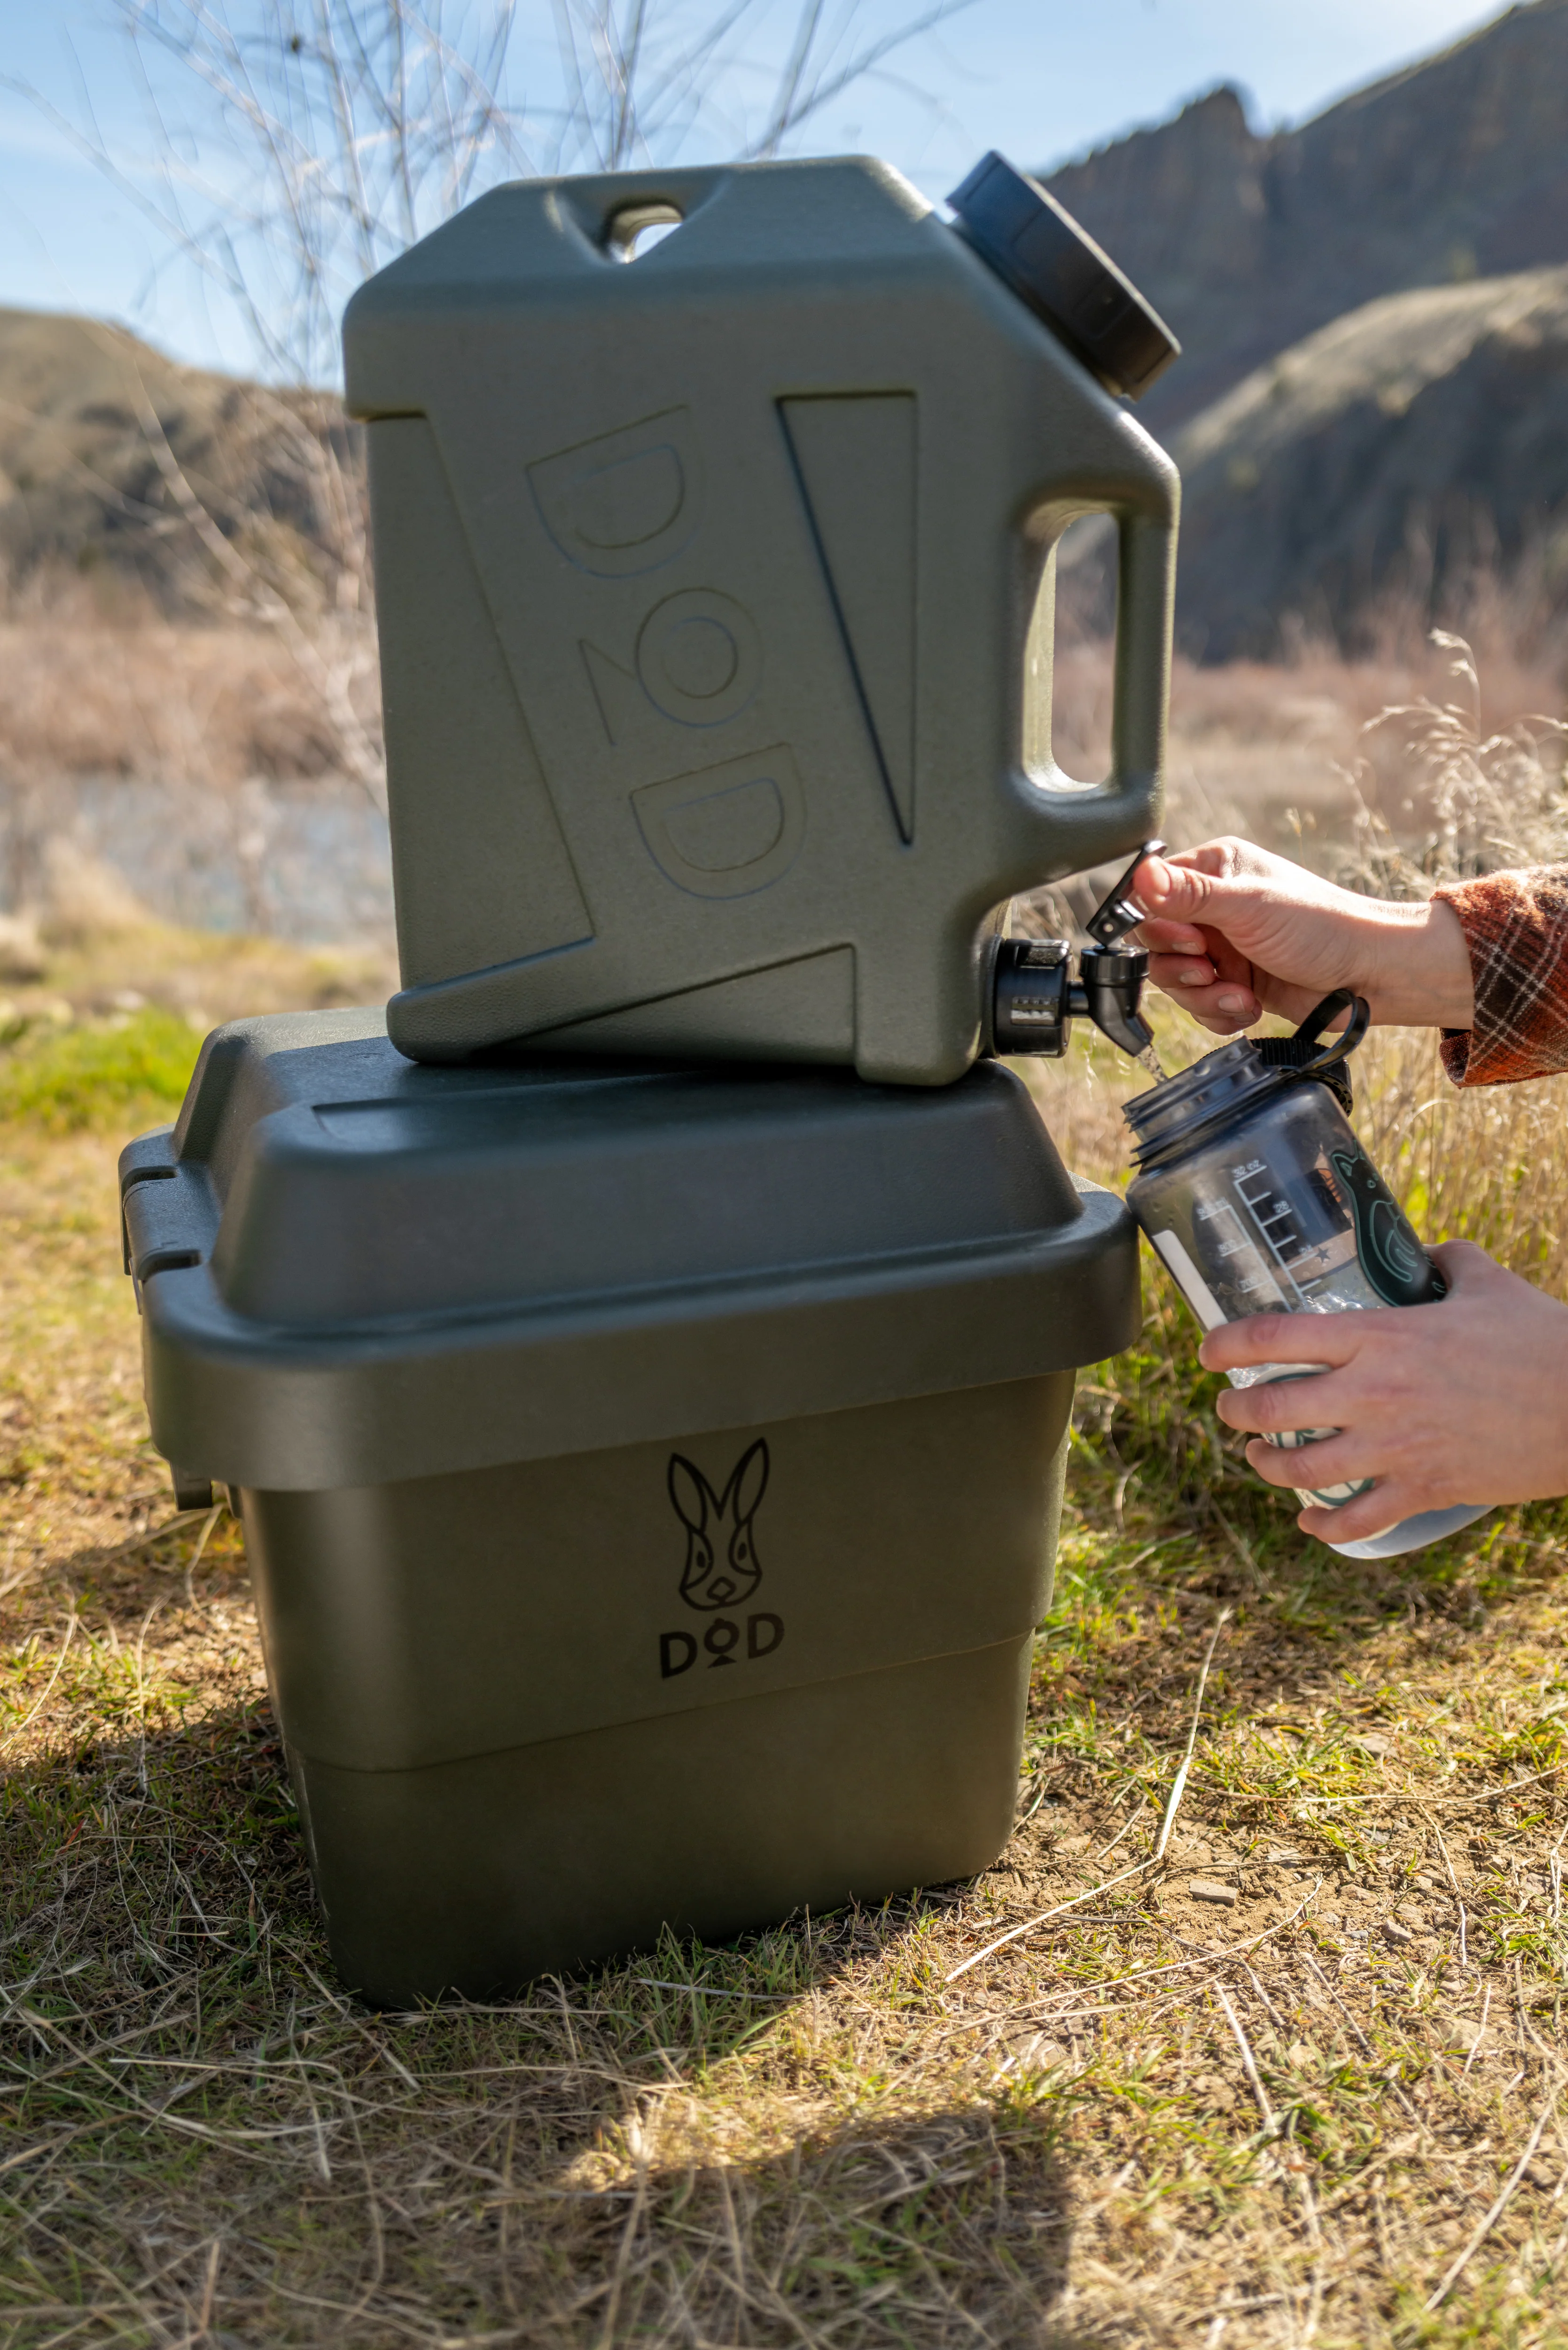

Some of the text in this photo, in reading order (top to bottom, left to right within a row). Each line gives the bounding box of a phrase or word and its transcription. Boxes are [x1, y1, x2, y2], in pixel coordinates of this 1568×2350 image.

[1231, 1165, 1247, 1178] 32
[1273, 1200, 1289, 1213] 28
[660, 1613, 785, 1678] DOD
